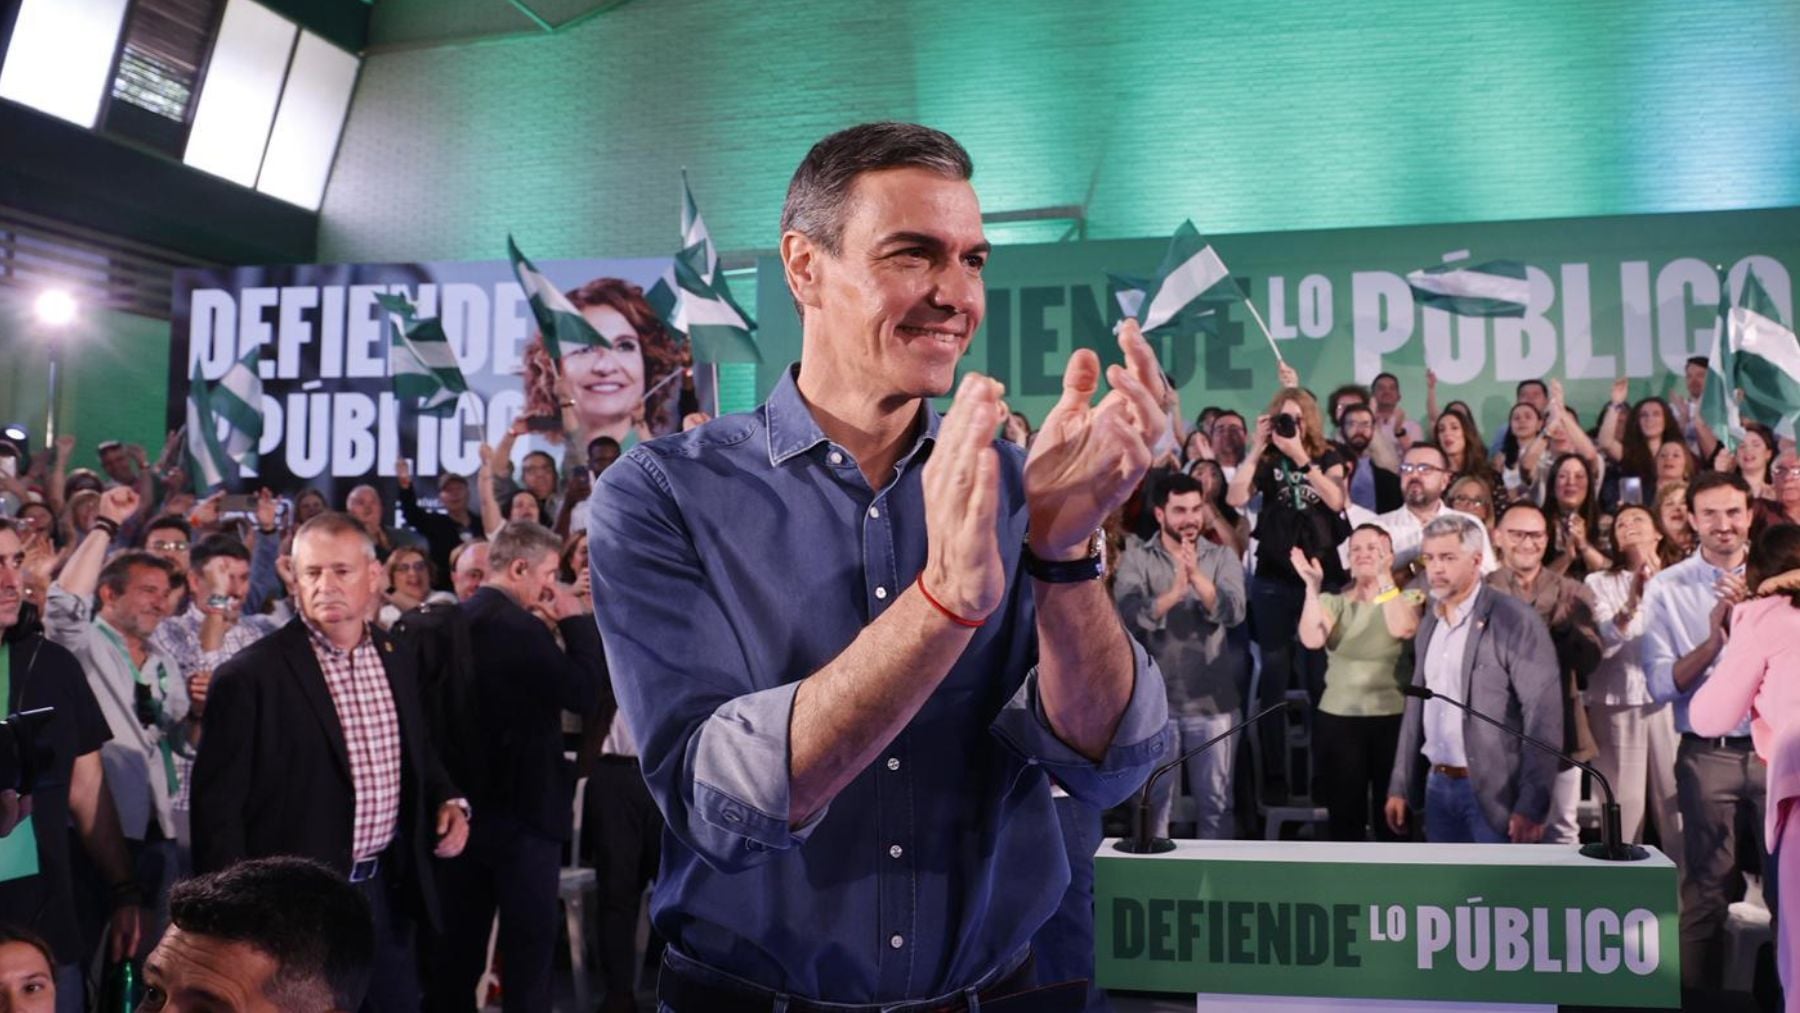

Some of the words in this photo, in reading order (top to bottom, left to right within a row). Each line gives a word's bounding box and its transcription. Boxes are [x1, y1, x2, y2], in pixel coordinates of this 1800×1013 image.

[986, 276, 1254, 397] IENE
[1268, 274, 1334, 340] LO
[1113, 898, 1361, 968] DEFIENDE
[1369, 904, 1407, 942] LO
[1416, 896, 1660, 976] PÚBLICO
